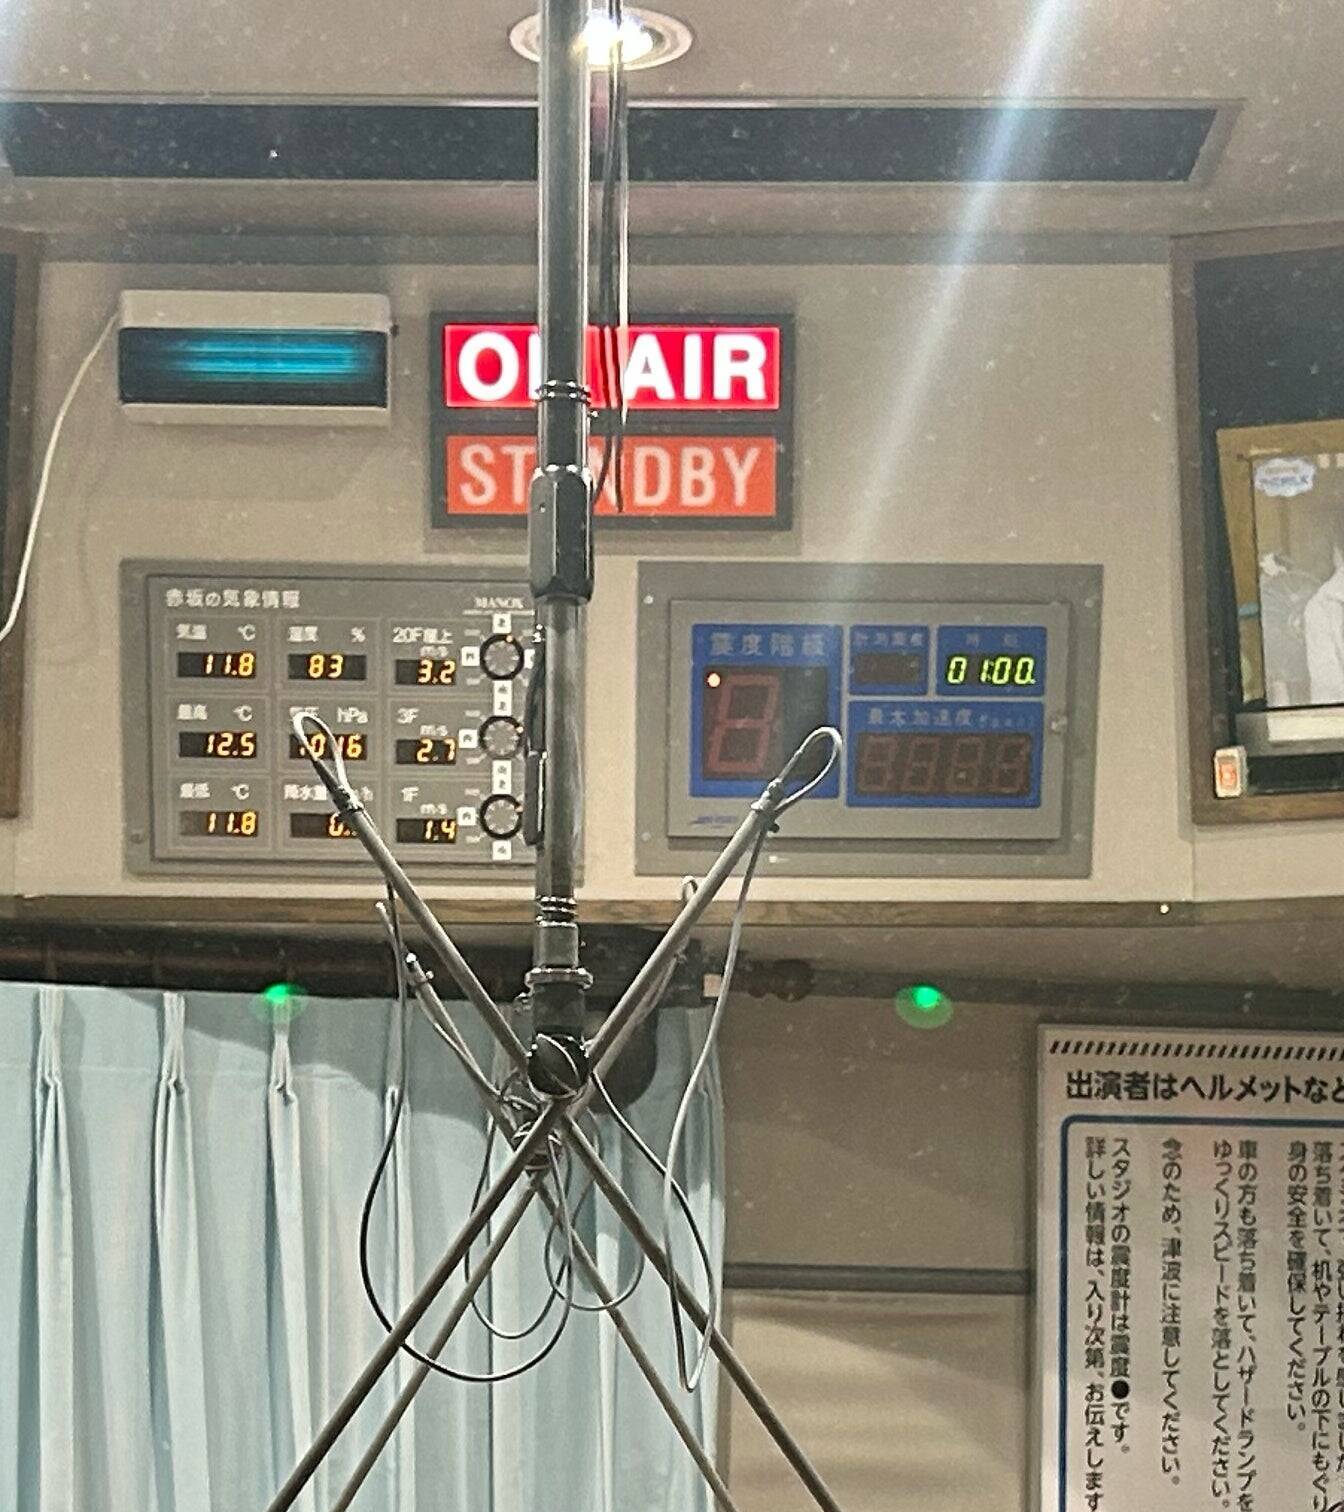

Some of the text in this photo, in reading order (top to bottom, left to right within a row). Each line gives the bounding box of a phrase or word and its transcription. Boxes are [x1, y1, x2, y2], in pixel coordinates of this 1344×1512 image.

[458, 330, 767, 401] O AIR
[459, 442, 761, 508] STNDBY
[204, 652, 255, 677] 11.8
[308, 653, 344, 679] 83
[417, 659, 456, 684] 3.2
[207, 732, 256, 757] 12.5
[416, 738, 456, 763] 2.7
[207, 808, 257, 836] 11.8
[425, 819, 456, 841] 1.4
[1287, 1140, 1309, 1432] 身の安全を確保してください。
